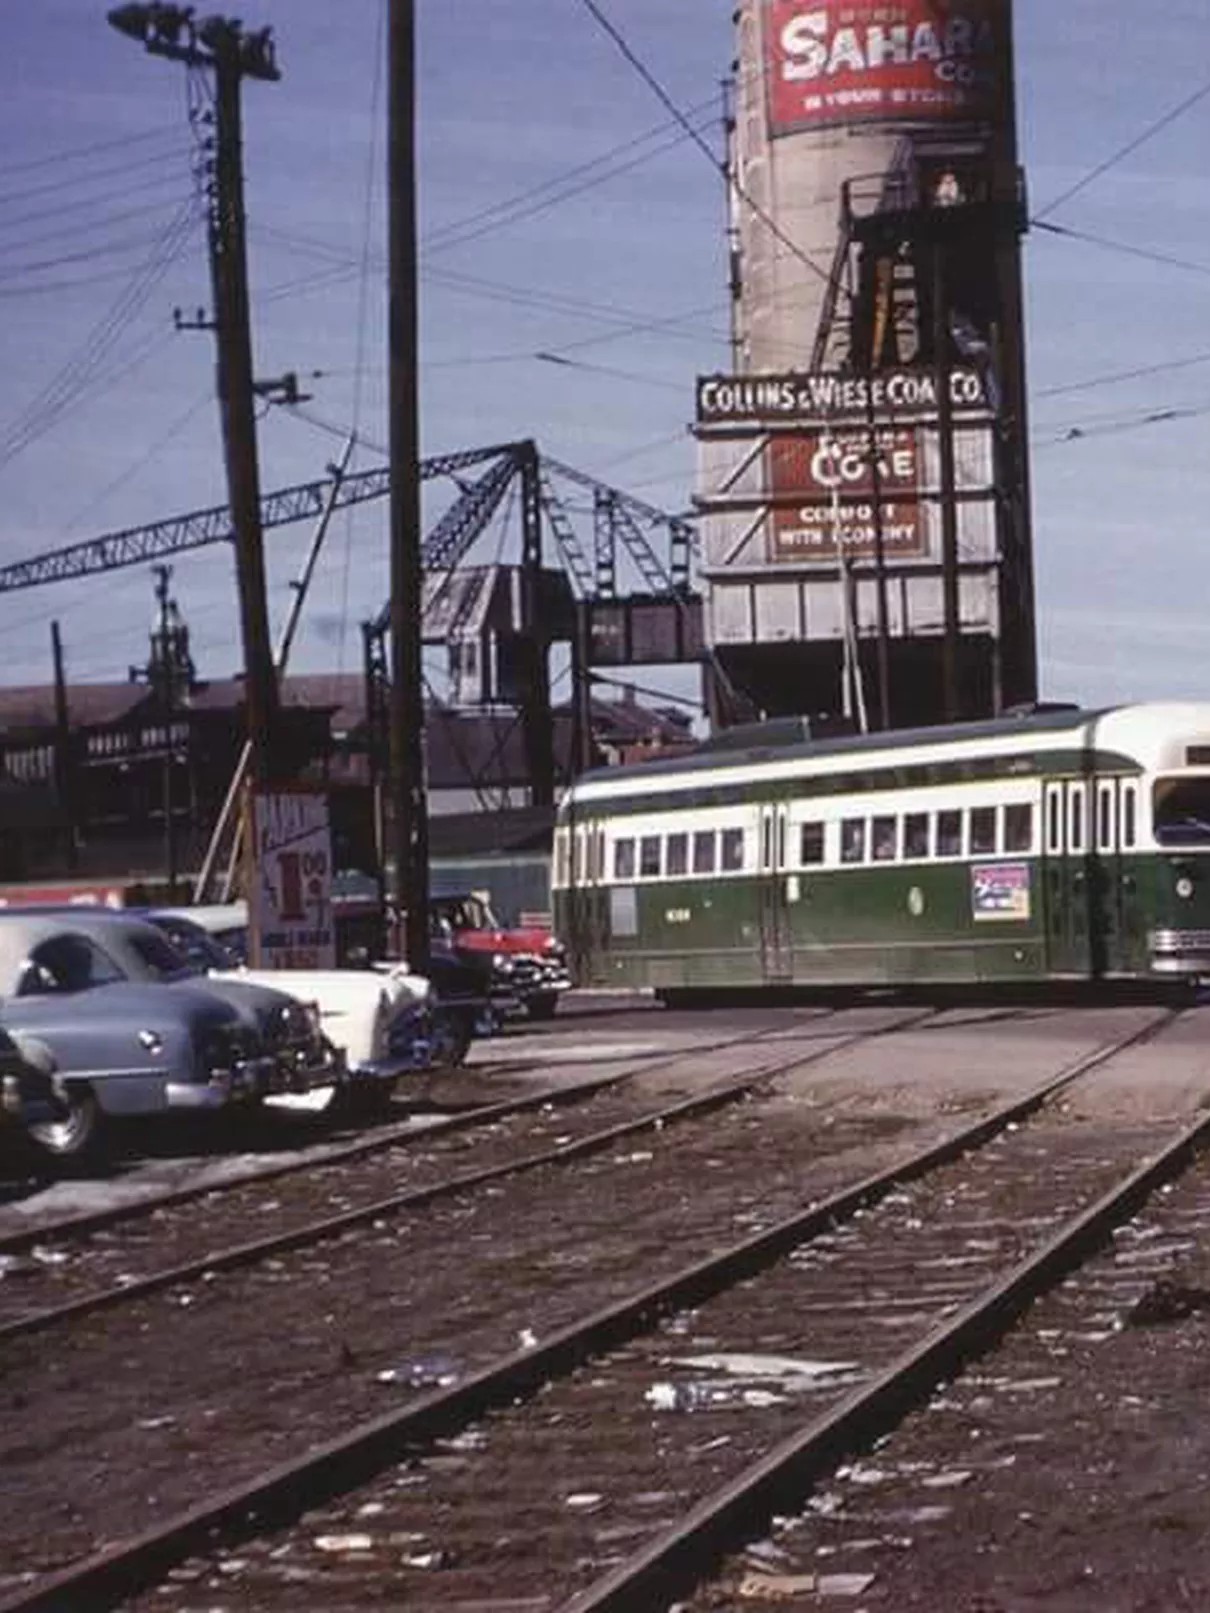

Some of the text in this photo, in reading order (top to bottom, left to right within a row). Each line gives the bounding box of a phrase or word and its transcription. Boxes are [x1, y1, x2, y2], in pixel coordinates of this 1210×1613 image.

[701, 381, 795, 413] COLLINS
[808, 375, 885, 408] WIESE
[886, 374, 938, 405] COA
